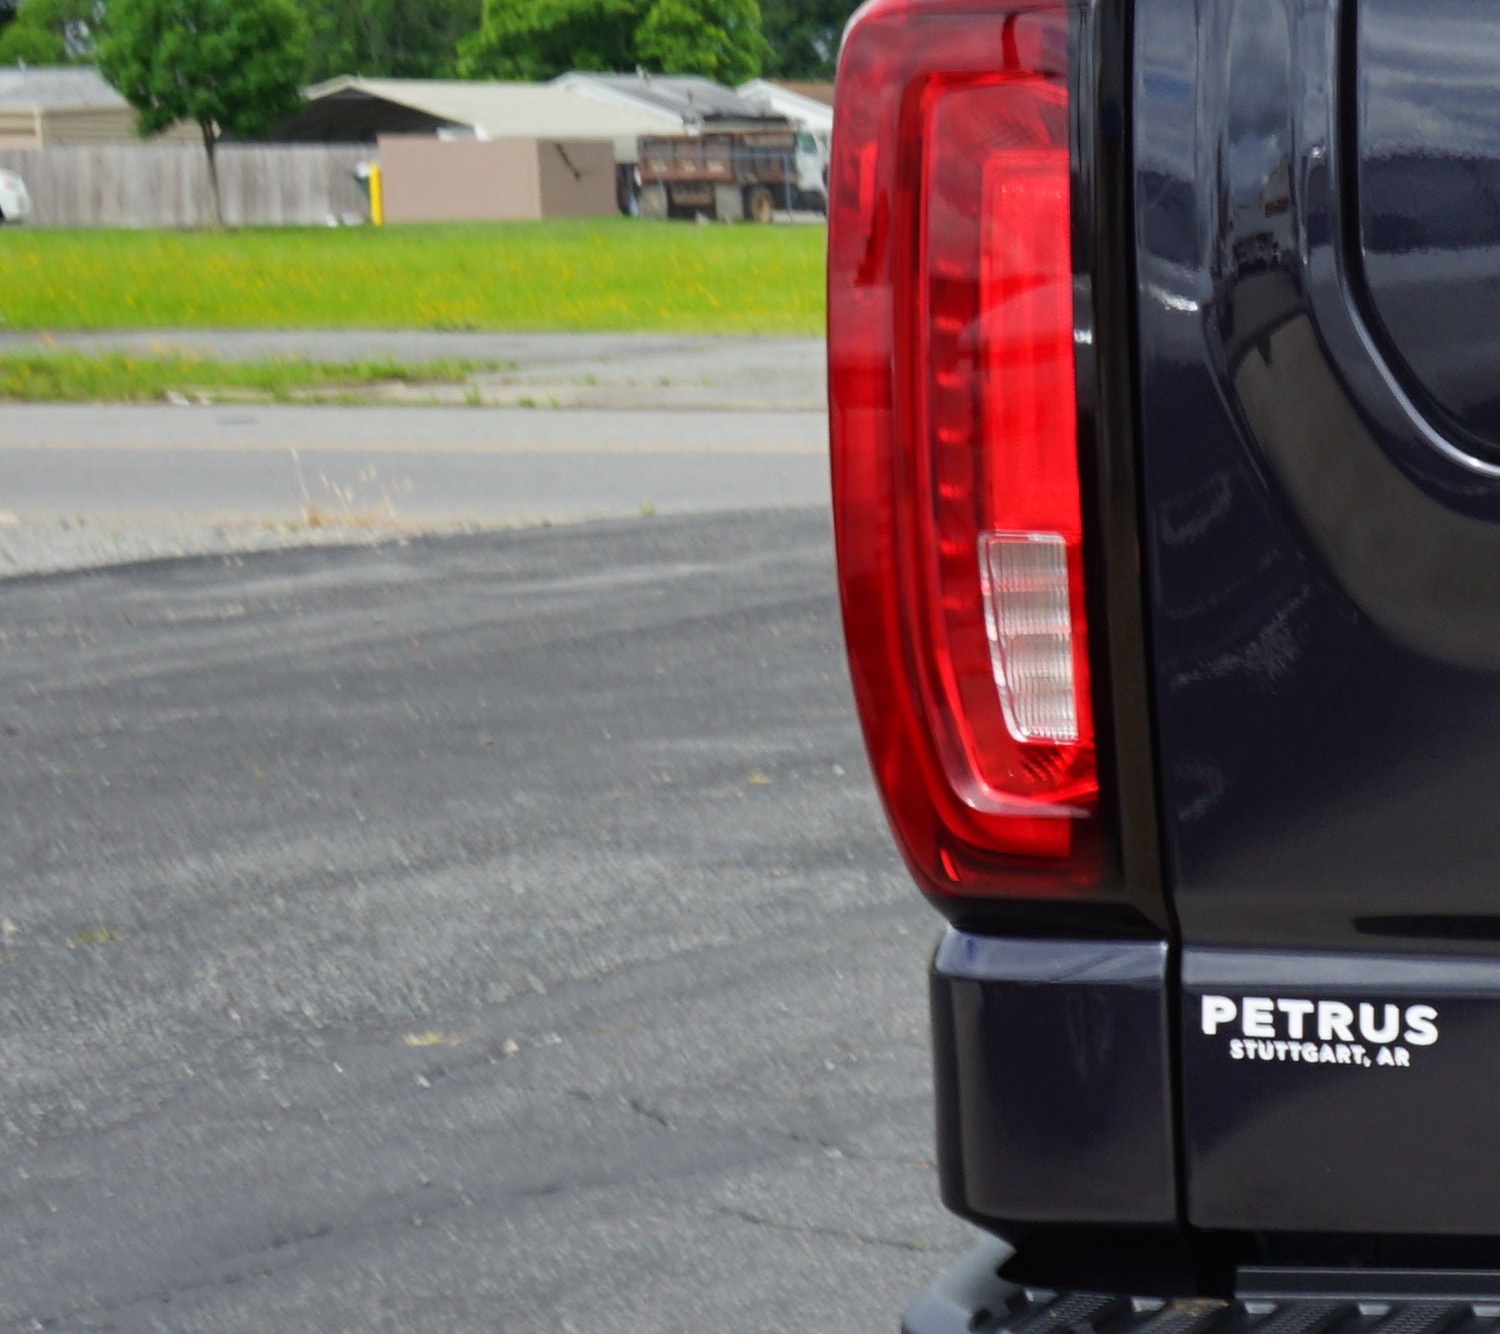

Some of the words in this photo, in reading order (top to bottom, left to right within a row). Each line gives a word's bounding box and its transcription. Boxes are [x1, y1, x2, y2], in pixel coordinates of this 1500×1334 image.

[1201, 994, 1440, 1046] PETRUS
[1229, 1038, 1372, 1068] STUTTGART,
[1376, 1045, 1411, 1068] AR
